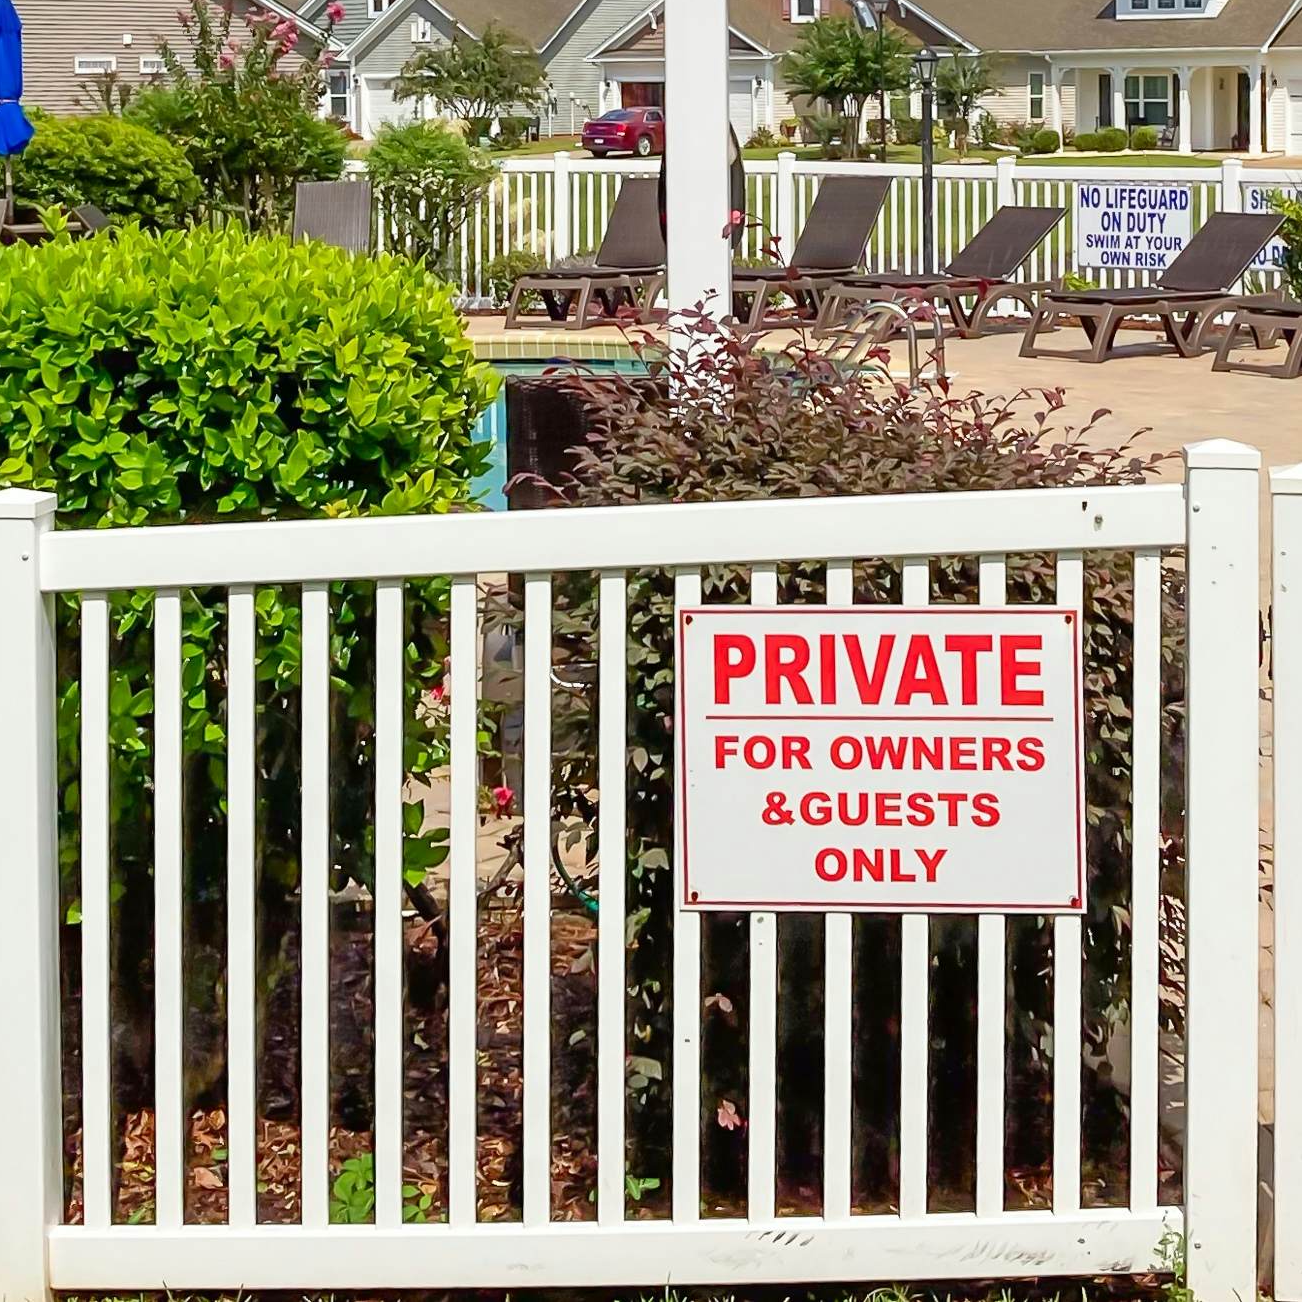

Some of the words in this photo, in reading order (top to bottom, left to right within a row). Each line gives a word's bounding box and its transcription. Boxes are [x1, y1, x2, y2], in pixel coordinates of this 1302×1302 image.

[1080, 187, 1101, 208] NO
[1105, 187, 1189, 211] LIFEGUARD
[1101, 211, 1122, 232] ON
[1126, 212, 1167, 234] DUTY
[1085, 233, 1120, 249] SWIM
[1124, 235, 1141, 250] AT
[1146, 236, 1183, 251] YOUR
[1100, 251, 1131, 266] OWN
[1135, 252, 1167, 267] RISK
[712, 633, 1045, 707] PRIVATE
[714, 735, 813, 770] FOR
[829, 735, 1046, 772] OWNERS
[761, 791, 1001, 828] &GUESTS
[814, 847, 948, 883] ONLY
